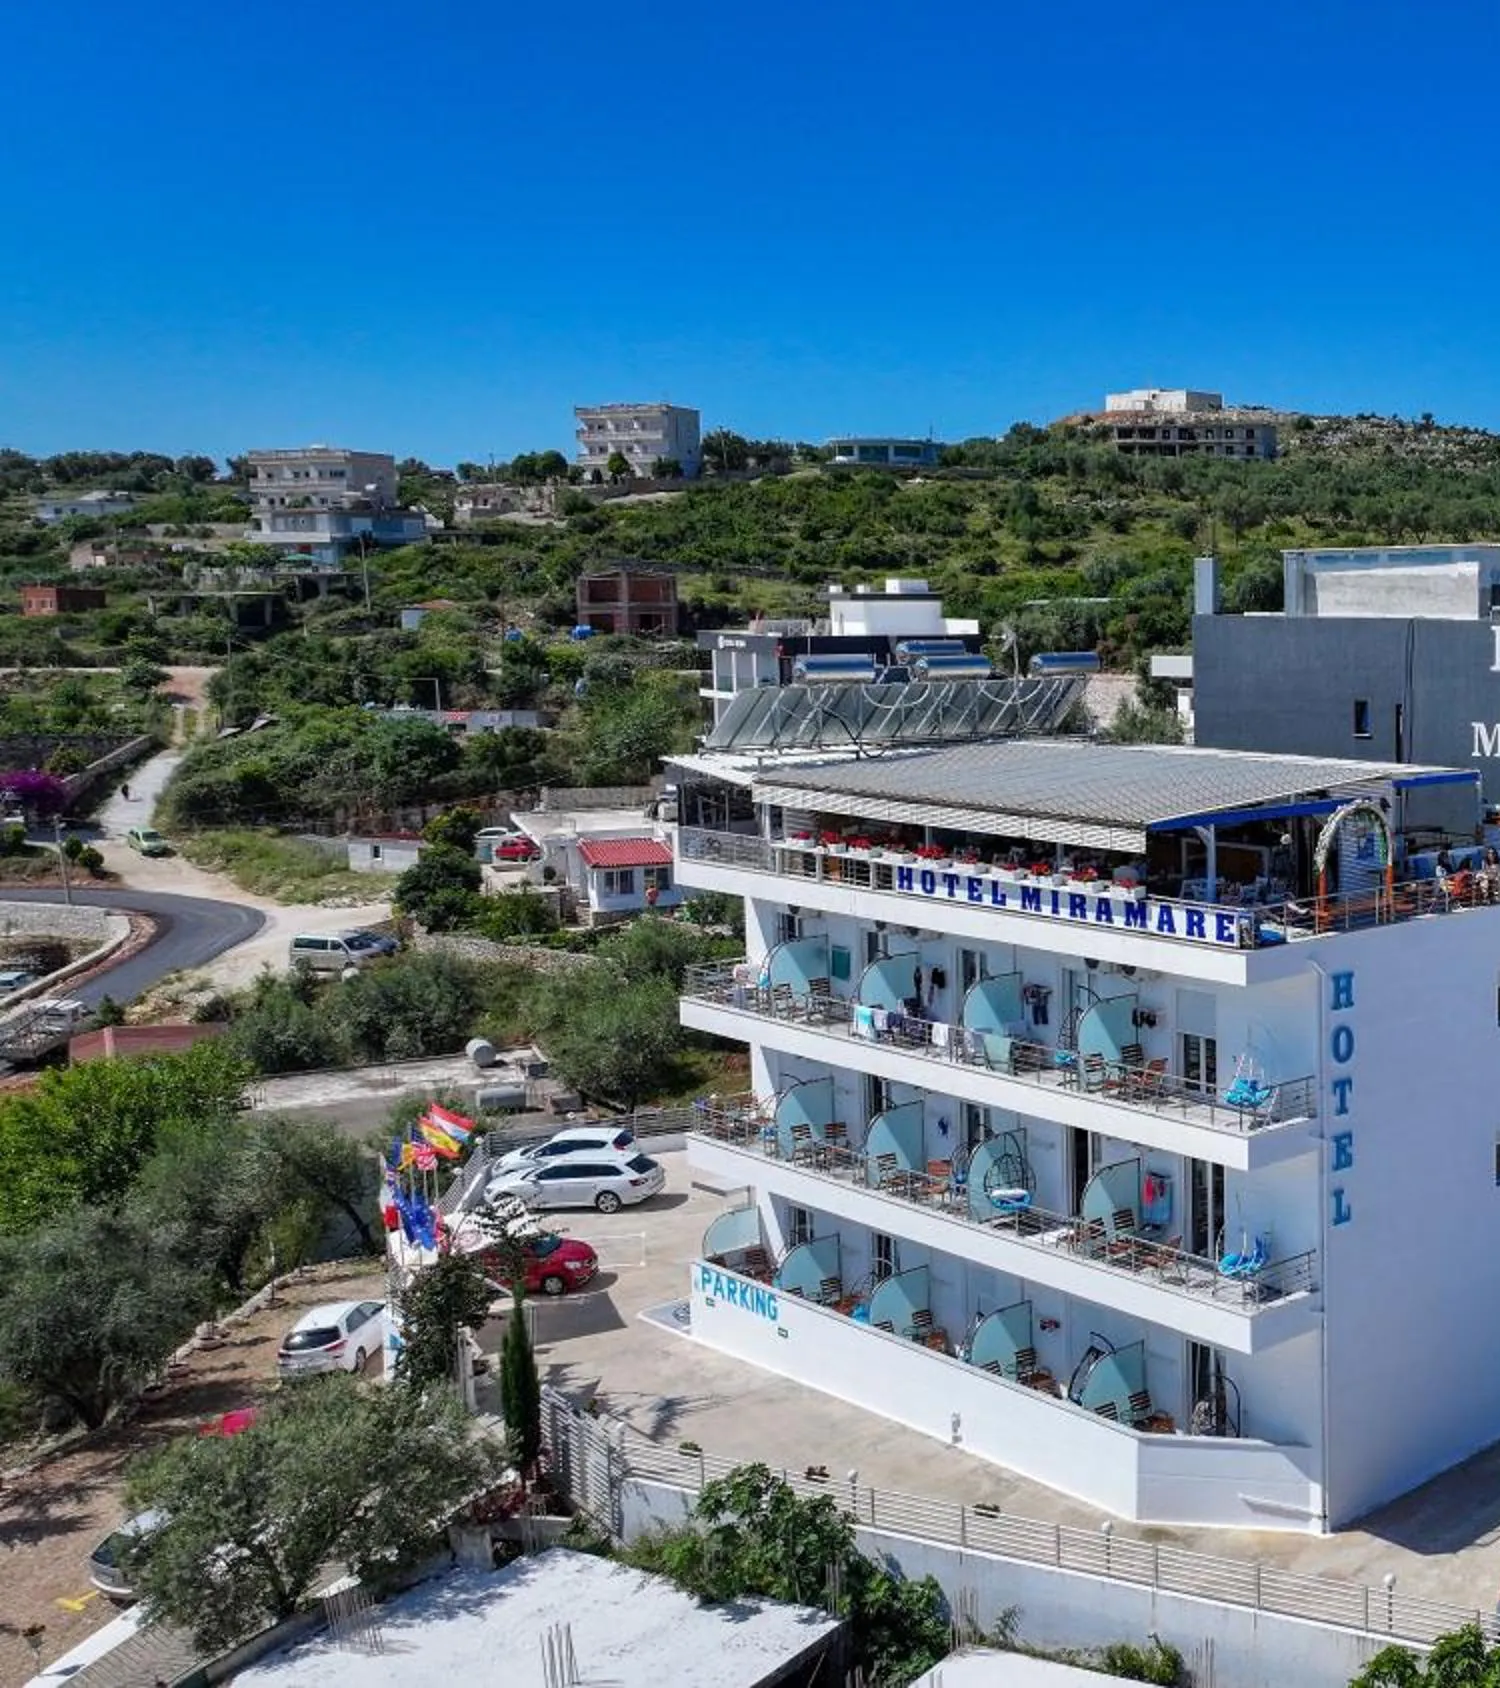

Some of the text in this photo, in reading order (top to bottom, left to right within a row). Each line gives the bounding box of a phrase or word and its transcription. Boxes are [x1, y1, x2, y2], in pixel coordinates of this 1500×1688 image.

[897, 865, 1007, 907] HOTEL
[1330, 970, 1355, 1226] HOTEL
[701, 1266, 778, 1321] PARKING
